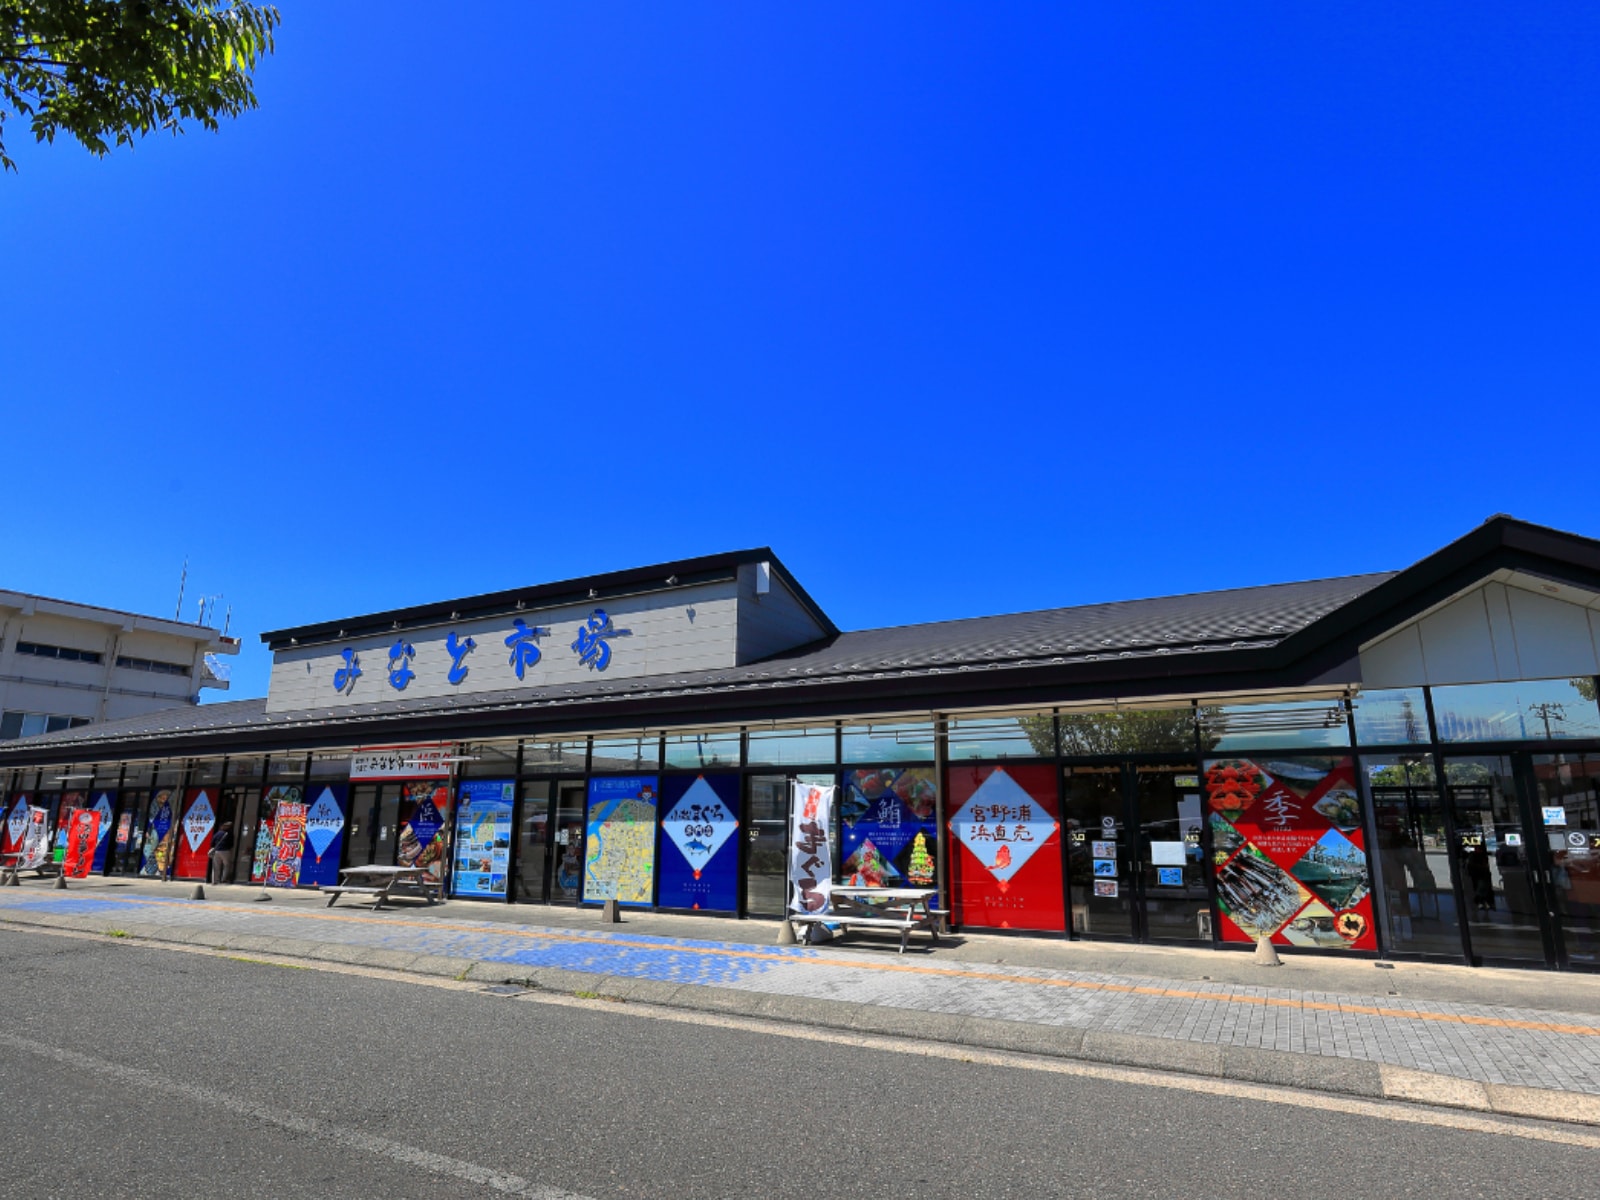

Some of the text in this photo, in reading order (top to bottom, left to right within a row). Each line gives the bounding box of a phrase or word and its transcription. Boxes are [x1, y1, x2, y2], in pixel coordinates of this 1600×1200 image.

[333, 609, 632, 696] みなと市場
[970, 804, 1032, 822] 宮野浦
[1263, 790, 1301, 825] 季
[970, 824, 1034, 842] 浜直売
[1462, 836, 1482, 845] 入口
[275, 822, 300, 882] 岩がき
[795, 821, 827, 912] まぐろ
